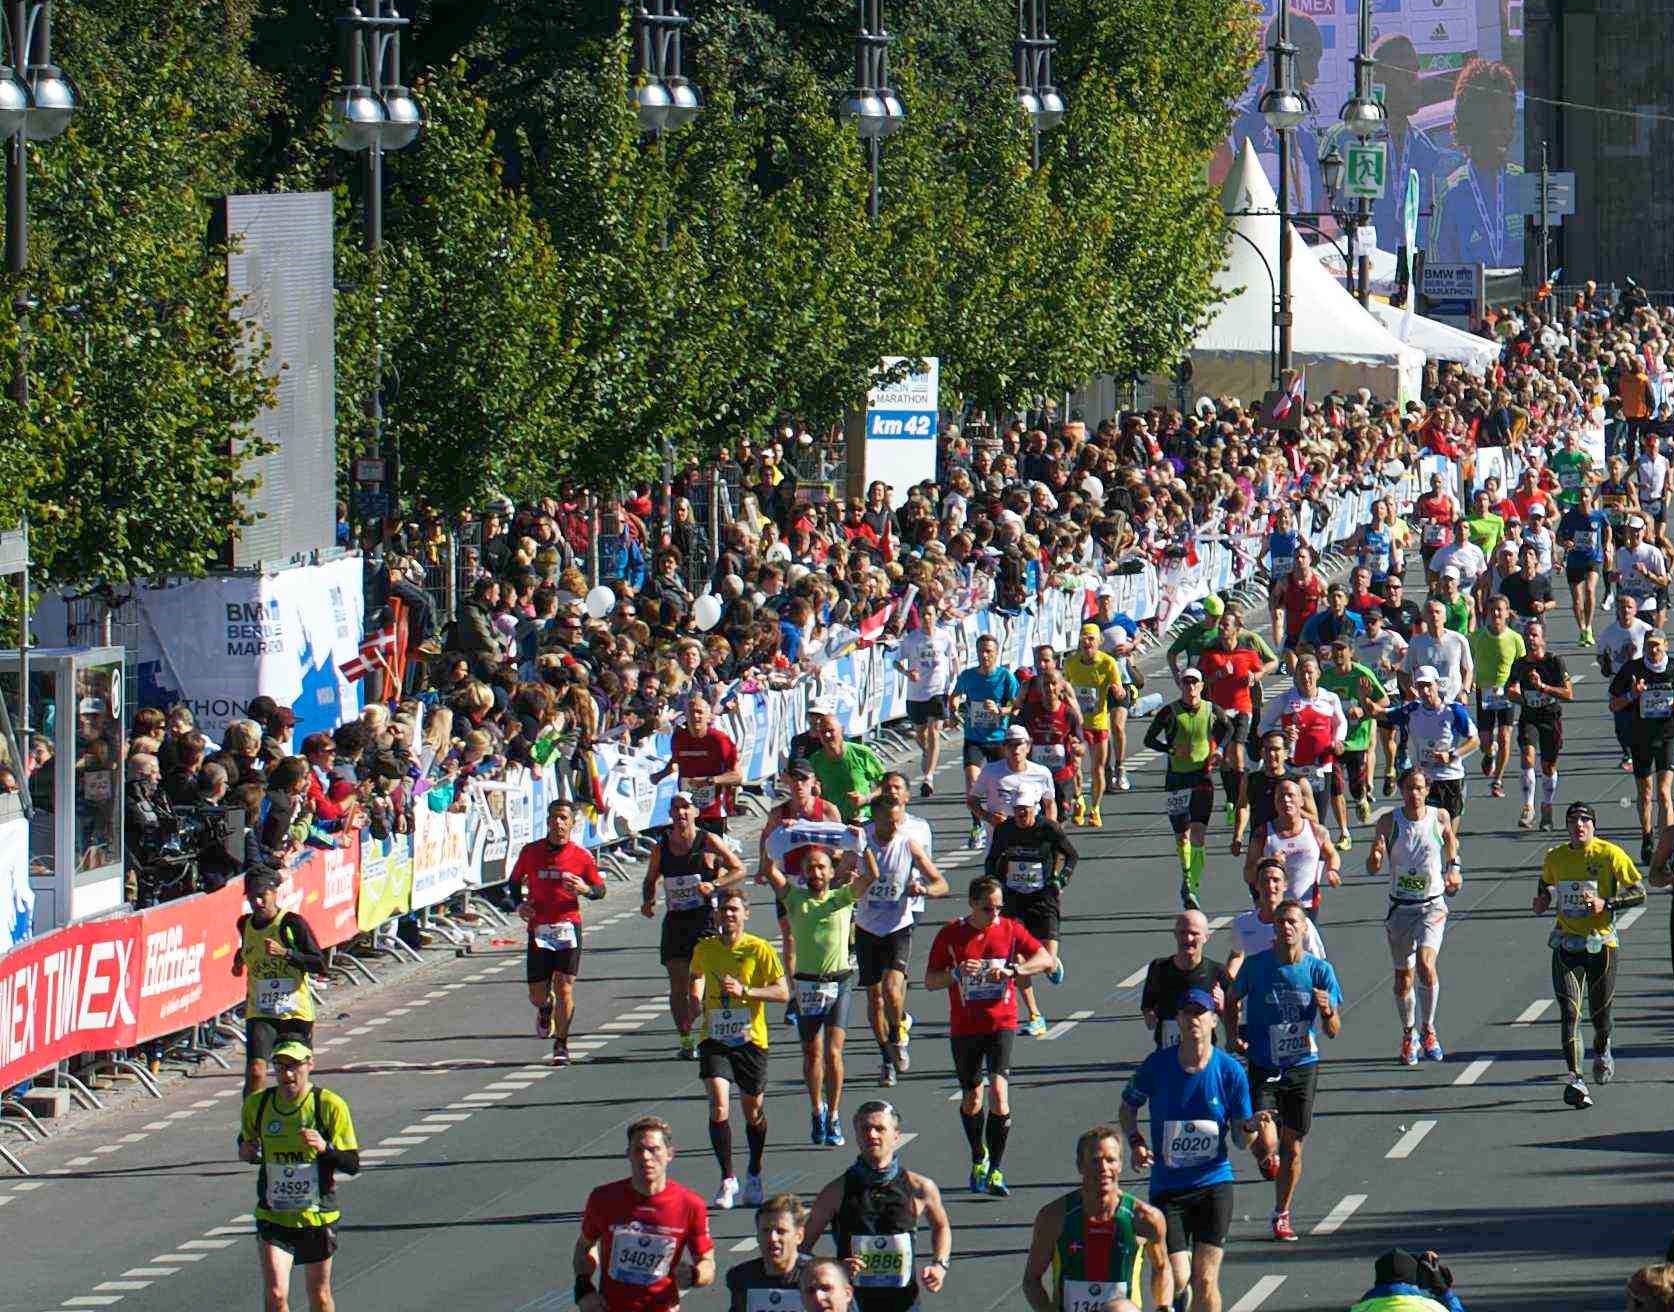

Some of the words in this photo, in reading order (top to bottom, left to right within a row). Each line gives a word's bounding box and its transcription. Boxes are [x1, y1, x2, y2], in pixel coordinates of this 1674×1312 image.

[1424, 268, 1454, 279] BMW
[1424, 288, 1473, 297] MARATHON
[877, 393, 928, 404] MARATHON
[872, 416, 903, 435] km
[904, 416, 932, 435] 42
[44, 937, 137, 1045] TIMEX
[1172, 1137, 1211, 1151] 6020
